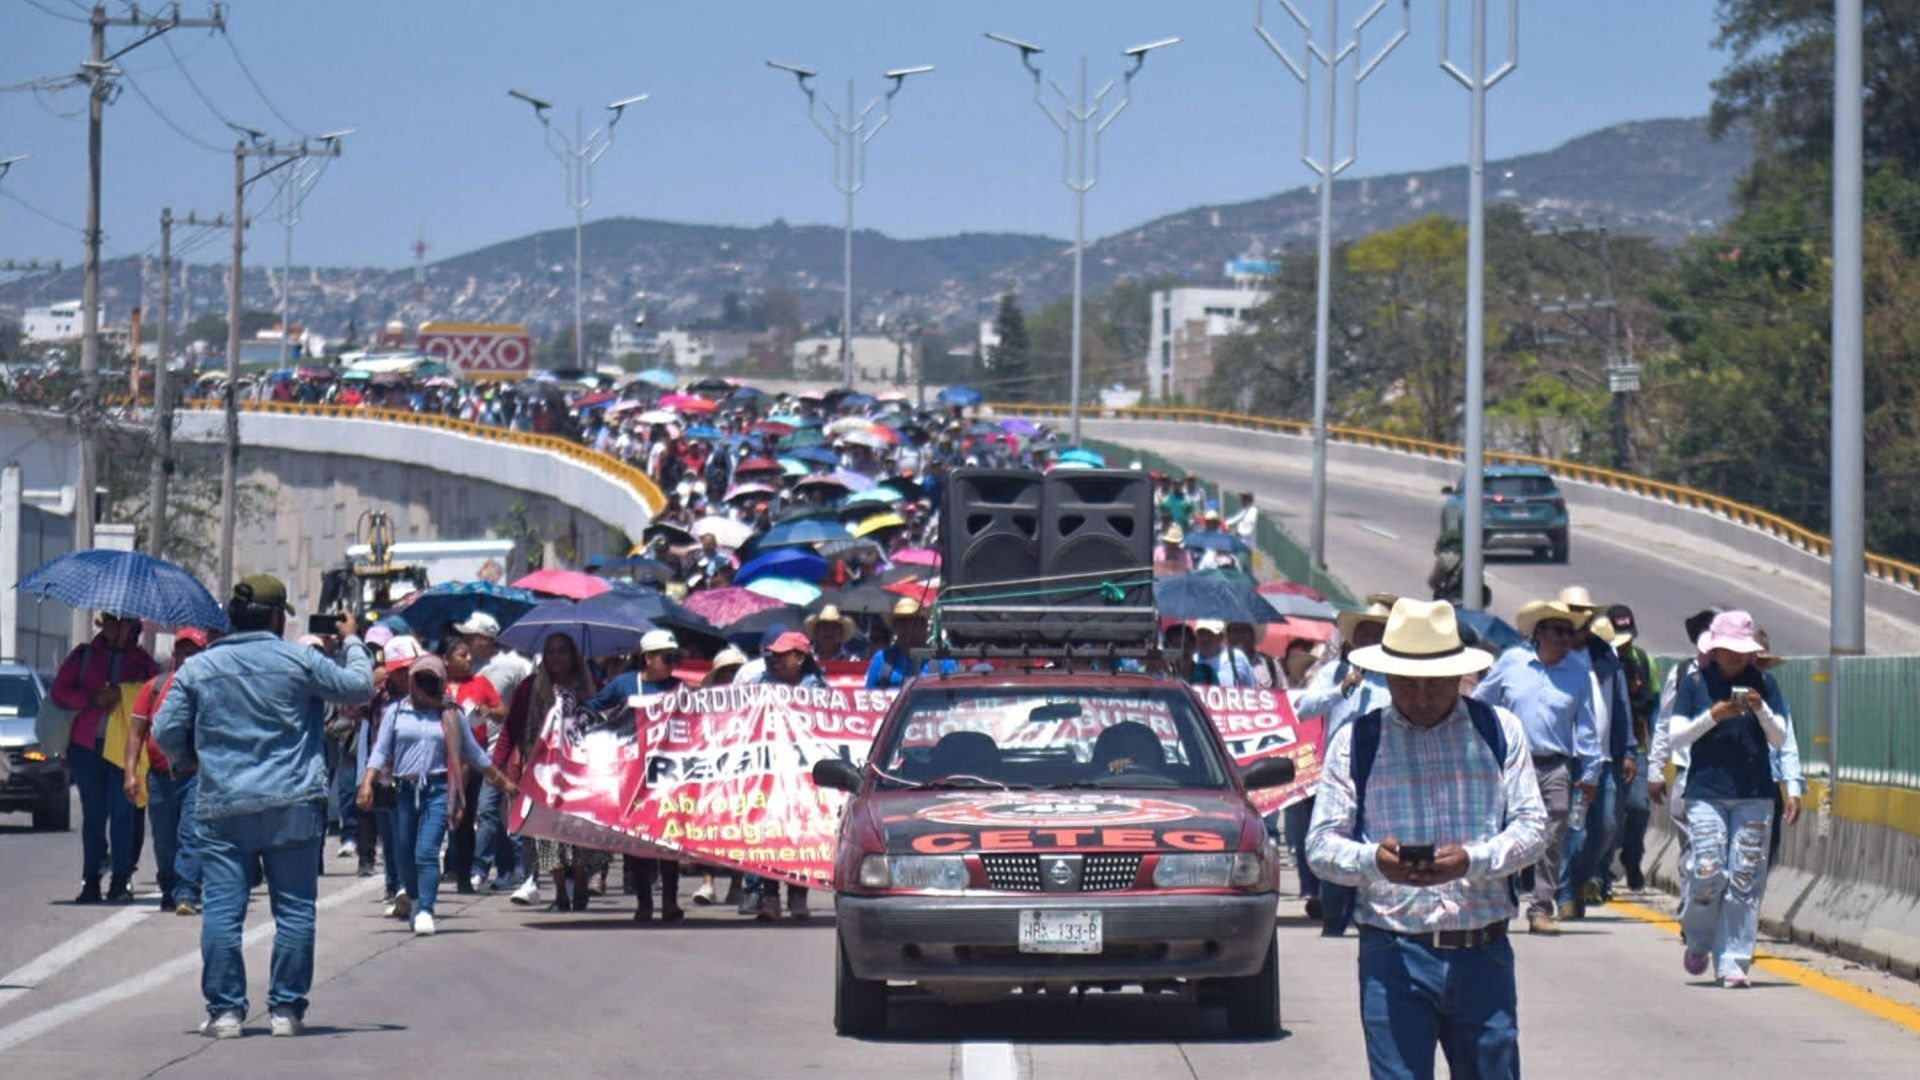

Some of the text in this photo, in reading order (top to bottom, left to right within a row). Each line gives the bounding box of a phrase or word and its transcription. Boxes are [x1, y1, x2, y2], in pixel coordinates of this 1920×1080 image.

[426, 336, 525, 369] OXXO
[646, 683, 848, 720] COORDINADORA
[646, 719, 690, 747] DE
[911, 829, 1225, 854] CETEG
